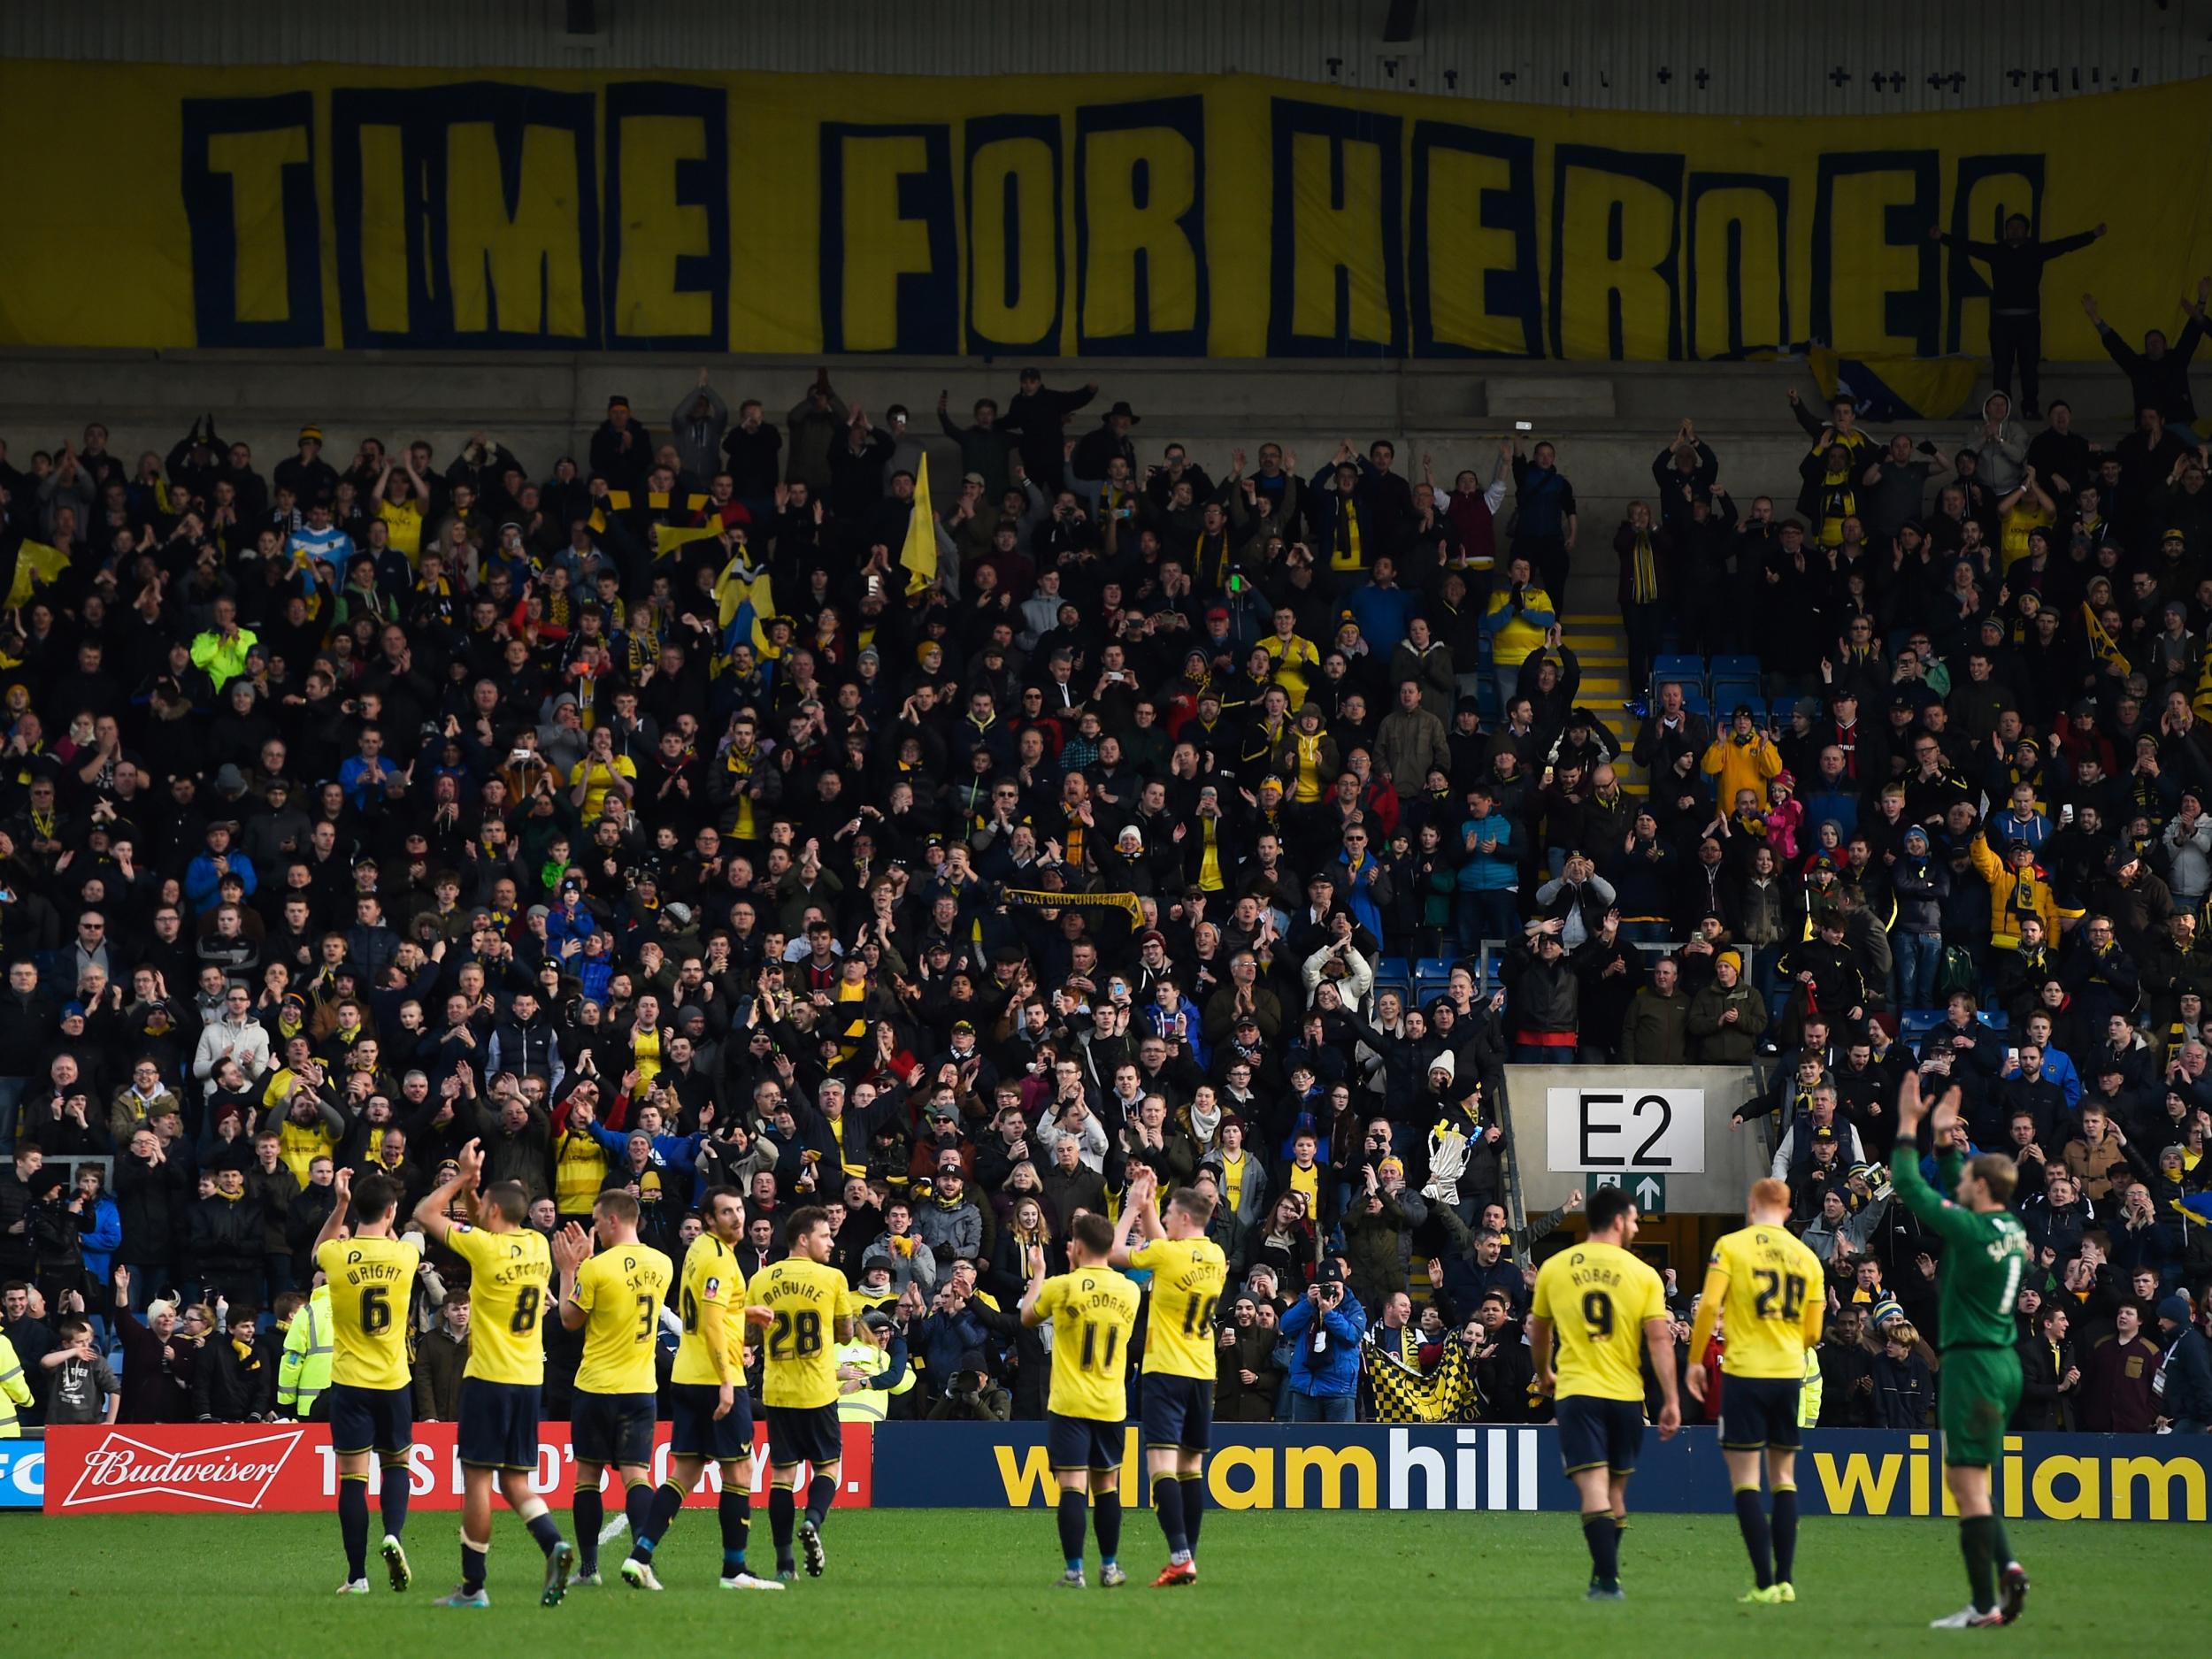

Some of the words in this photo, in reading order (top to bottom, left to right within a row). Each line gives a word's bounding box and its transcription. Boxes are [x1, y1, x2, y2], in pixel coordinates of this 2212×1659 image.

[207, 115, 713, 338] TIME
[841, 127, 1196, 350] FOR
[1024, 894, 1071, 905] OXFORD
[1579, 1094, 1672, 1166] E2
[347, 1263, 403, 1286] WRIGHT
[626, 1271, 663, 1292] SKARZ
[763, 1280, 824, 1307] MAGUIRE
[1572, 1268, 1622, 1288] HOBAN
[1998, 1256, 2022, 1314] 1
[360, 1285, 392, 1337] 6
[511, 1284, 541, 1338] 8
[635, 1293, 654, 1344] 3
[770, 1309, 823, 1362] 28
[1582, 1289, 1614, 1343] 9
[1080, 1319, 1119, 1372] 11
[85, 1448, 279, 1487] Budweiser
